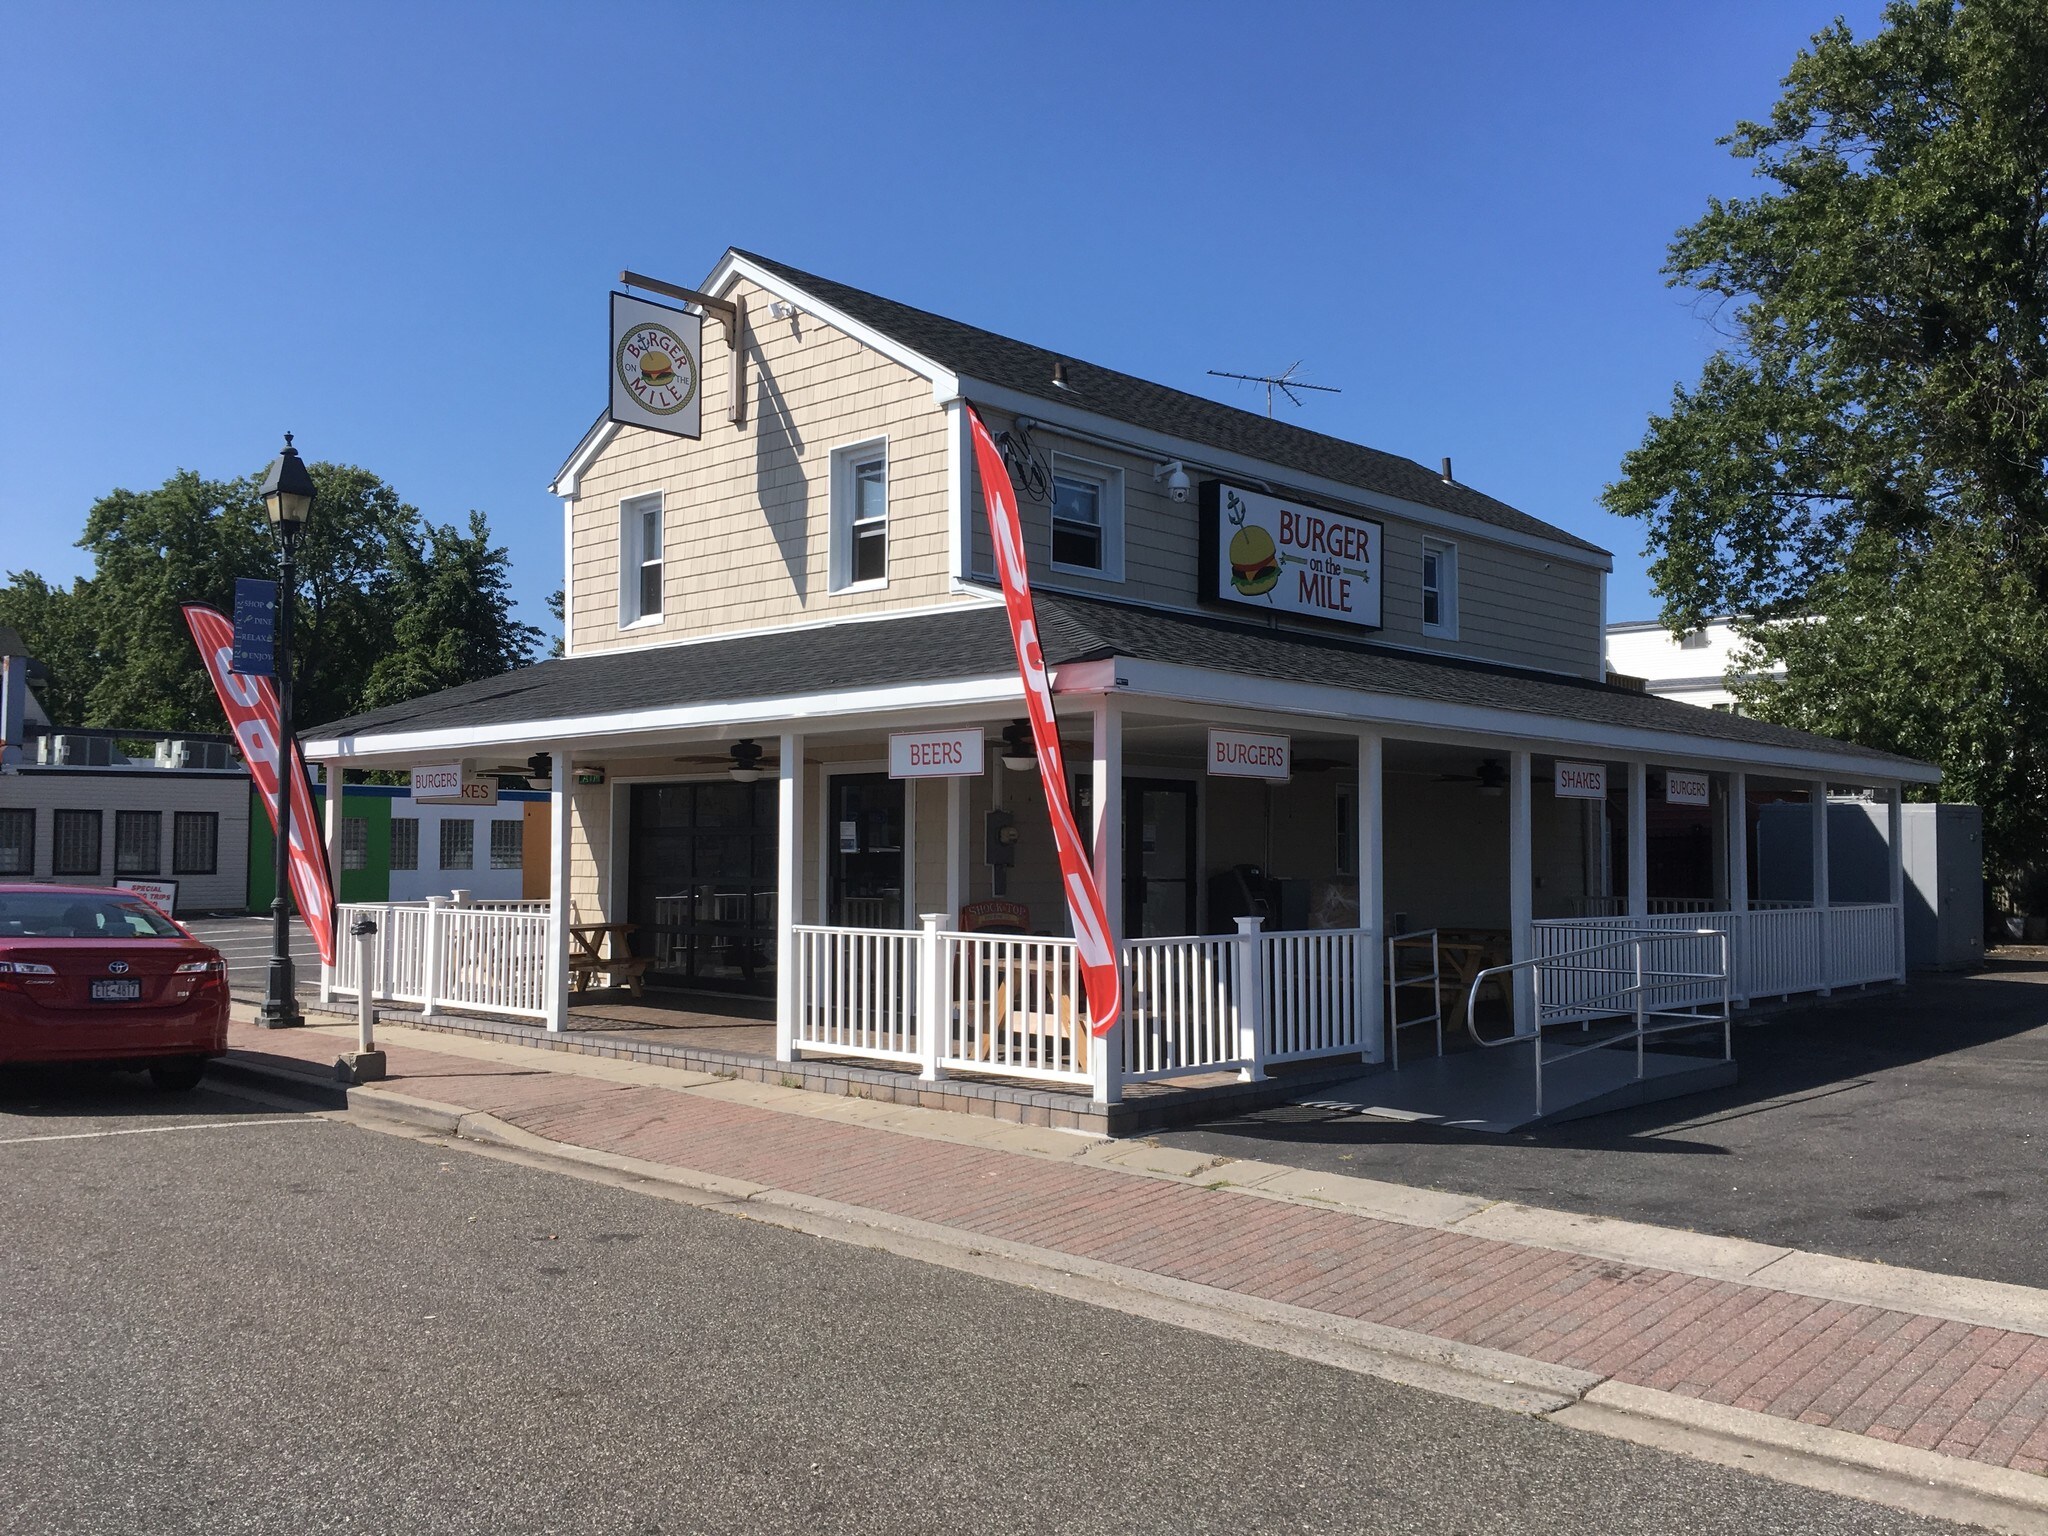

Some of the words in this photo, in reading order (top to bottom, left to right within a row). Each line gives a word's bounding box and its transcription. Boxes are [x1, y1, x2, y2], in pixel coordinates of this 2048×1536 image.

[625, 363, 637, 373] ON
[676, 375, 690, 386] THE
[630, 376, 683, 407] MILE
[1279, 509, 1370, 564] BURGER
[1310, 557, 1323, 573] on
[1325, 556, 1341, 576] the
[1298, 570, 1353, 613] MILE
[244, 599, 265, 609] SHOP
[254, 617, 273, 626] DINE
[241, 633, 266, 642] RELAX
[910, 741, 963, 766] BEERS
[1216, 741, 1284, 767] BURGERS
[415, 772, 458, 789] BURGERS
[1561, 769, 1601, 791] SHAKES
[1670, 778, 1706, 797] BURGERS
[460, 784, 489, 799] KES
[131, 884, 162, 893] SPECIAL
[150, 893, 171, 901] TRIPS
[967, 903, 1003, 916] SHOCK
[1005, 903, 1026, 916] TOP
